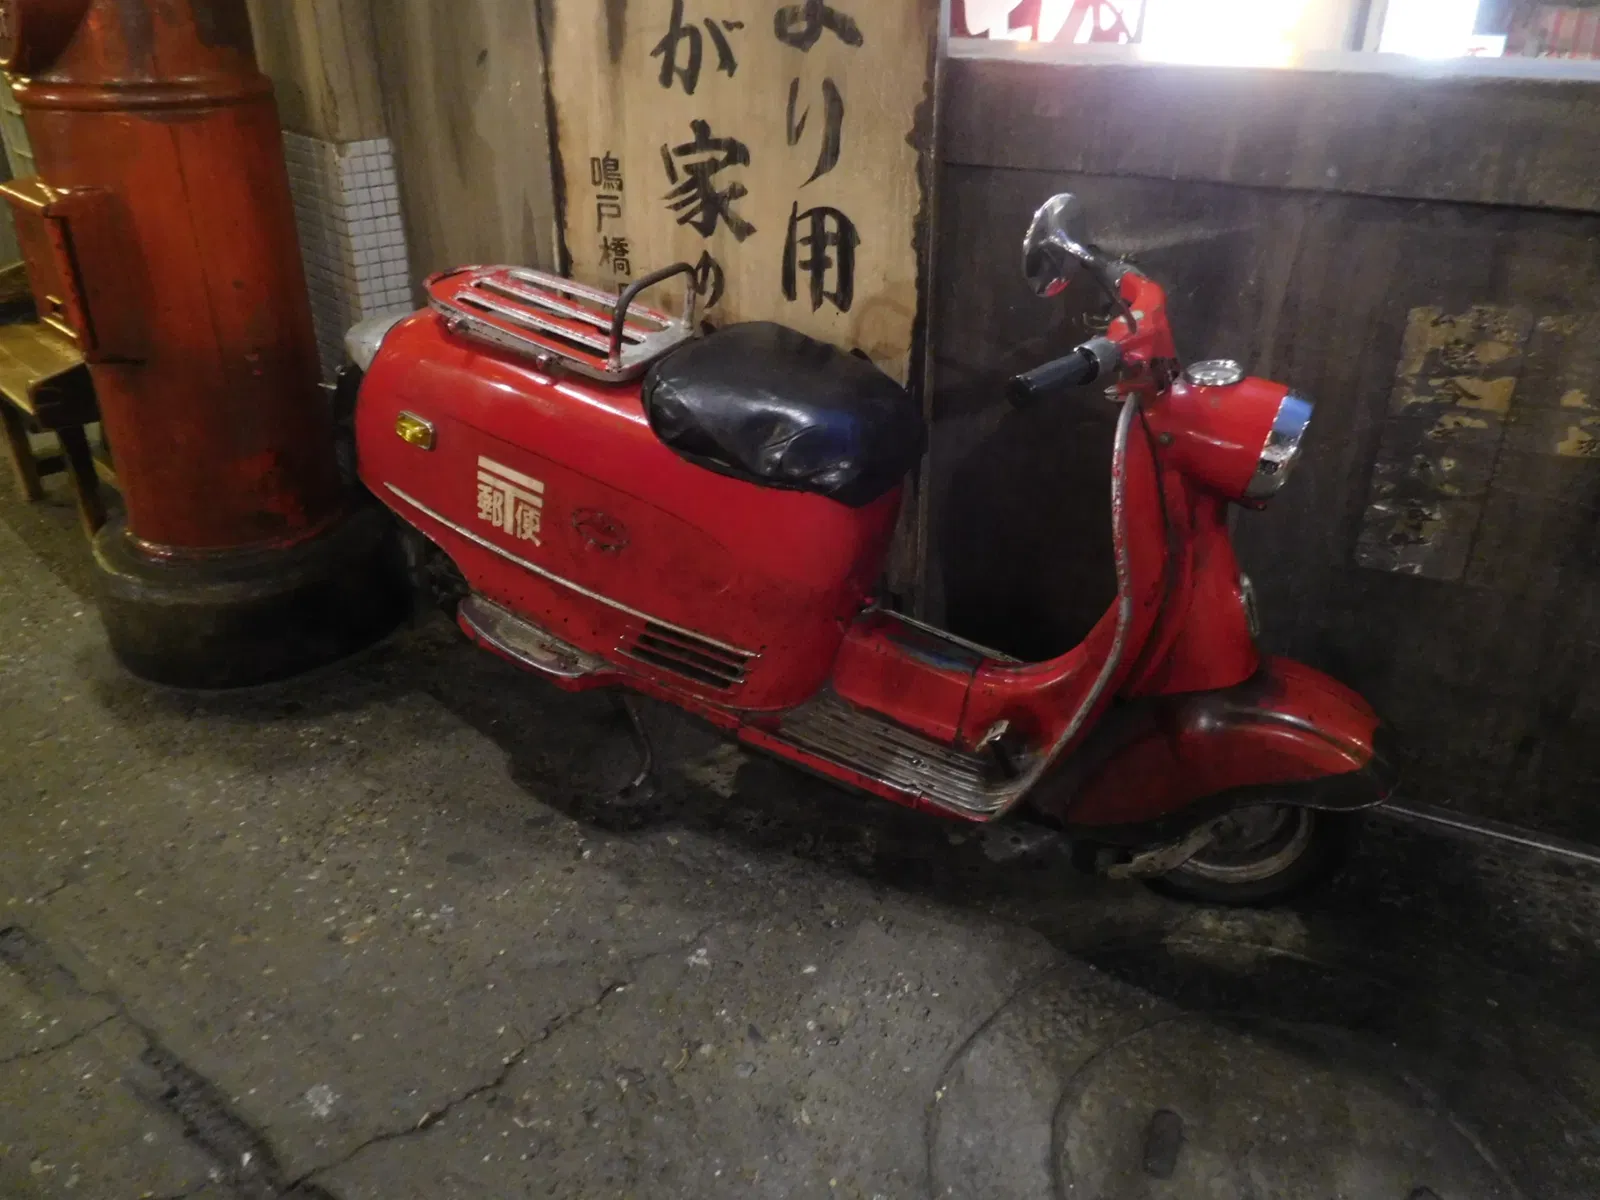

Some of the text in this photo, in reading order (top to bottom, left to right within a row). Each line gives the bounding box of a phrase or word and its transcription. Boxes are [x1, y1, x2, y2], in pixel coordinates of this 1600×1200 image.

[590, 151, 632, 296] 鳴戸橋
[650, 0, 757, 334] が家の
[774, 0, 869, 361] より用
